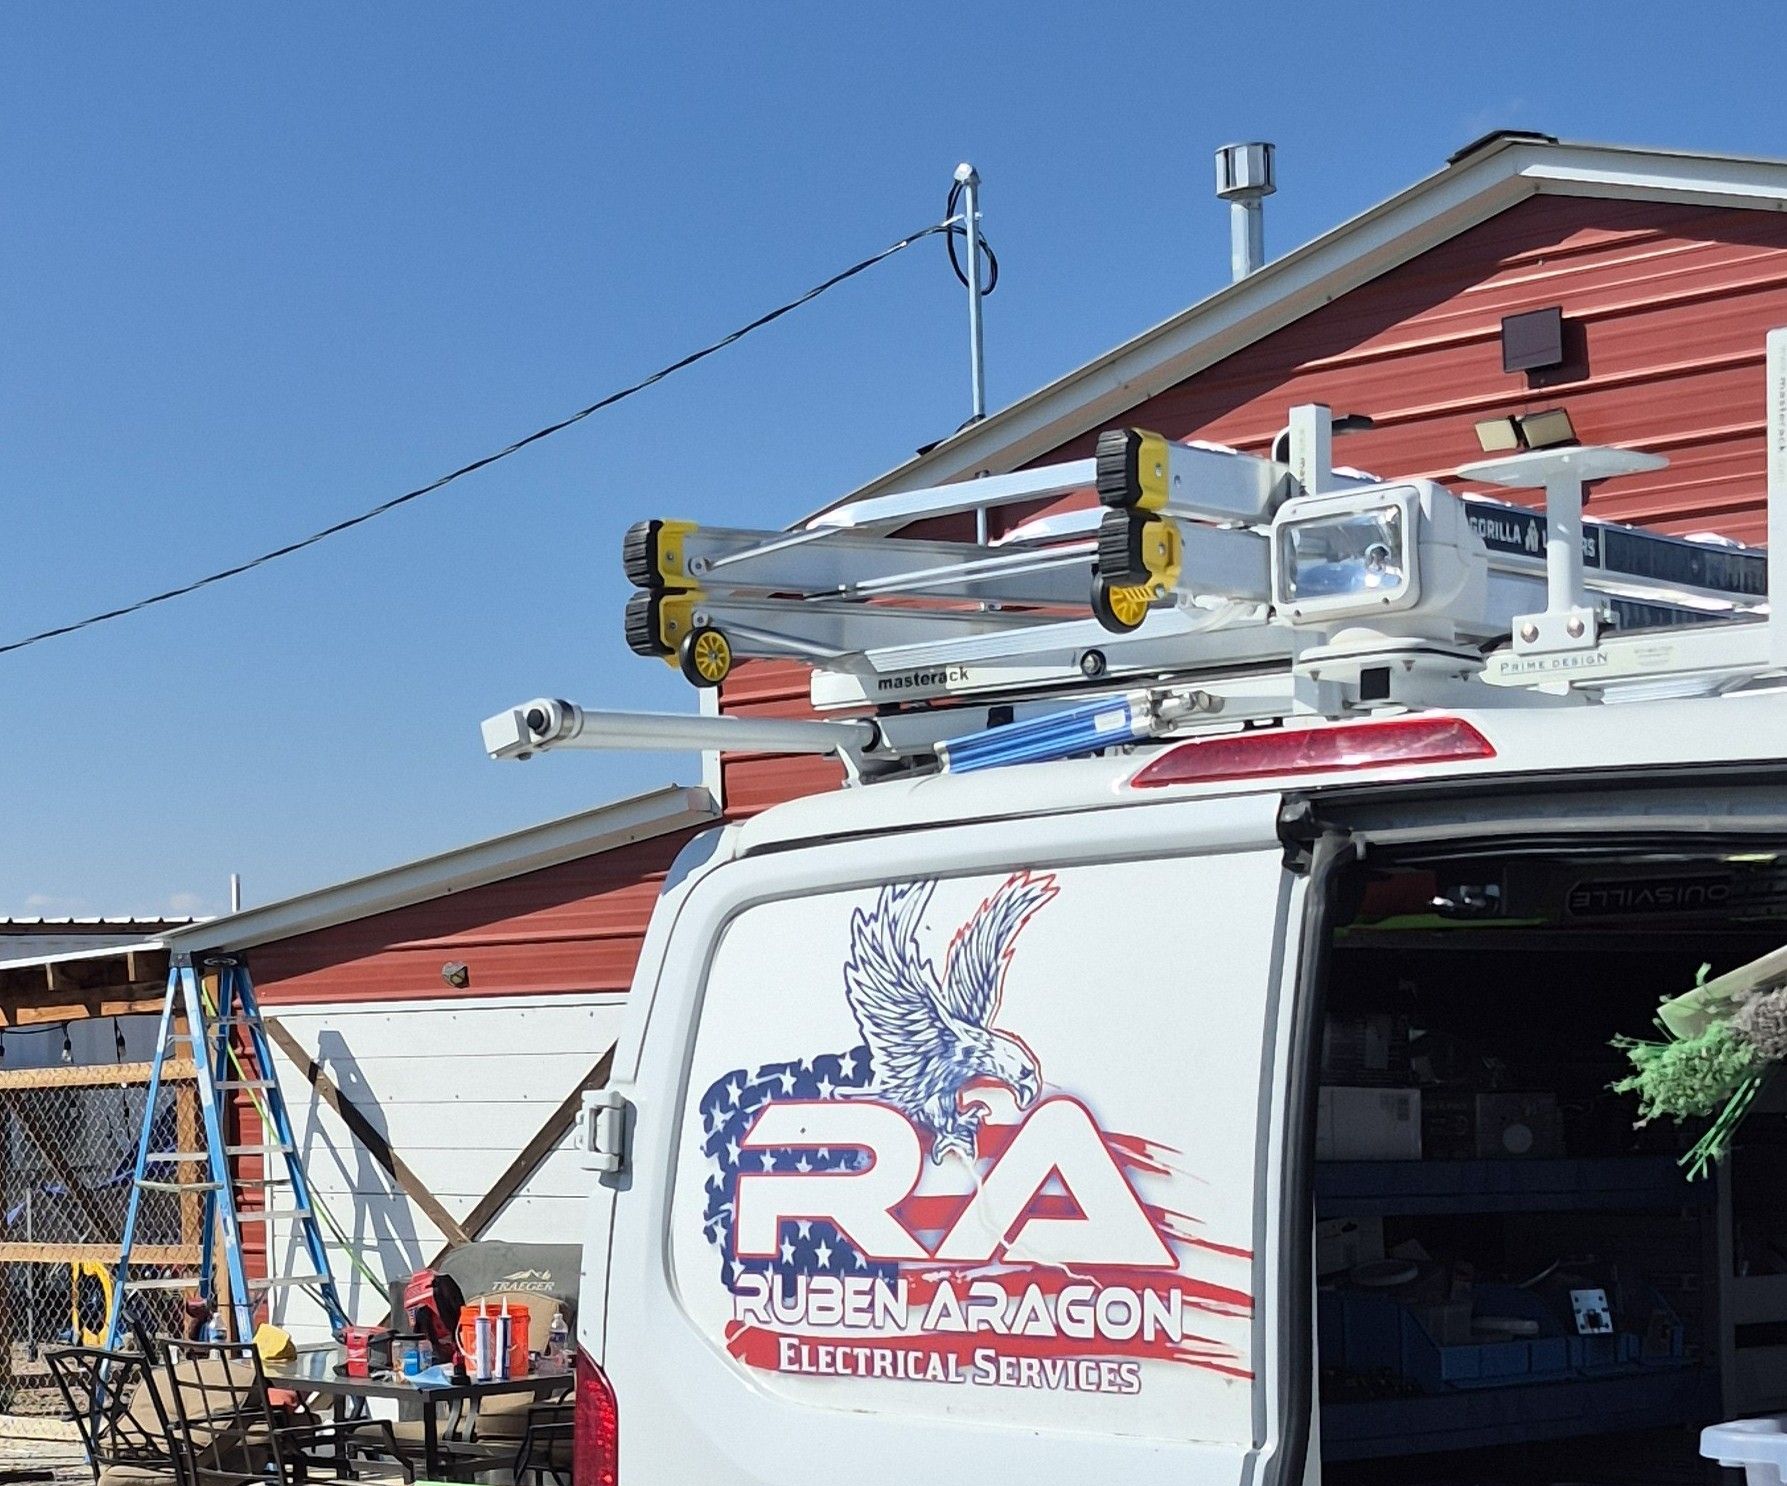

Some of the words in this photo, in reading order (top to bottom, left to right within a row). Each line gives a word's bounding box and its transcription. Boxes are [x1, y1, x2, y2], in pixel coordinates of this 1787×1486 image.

[1469, 516, 1522, 545] GORILLA
[1500, 660, 1545, 672] PRIME
[1552, 652, 1608, 668] DESIGN
[878, 665, 969, 690] masterack
[1574, 883, 1731, 906] OUISVILLE
[733, 1097, 1180, 1270] RA
[492, 1281, 555, 1291] TRAEGER
[732, 1273, 910, 1330] RUBEN
[921, 1281, 1184, 1344] ARAGON
[778, 1337, 964, 1384] ELECTRICAL
[972, 1347, 1142, 1395] SERVICES
